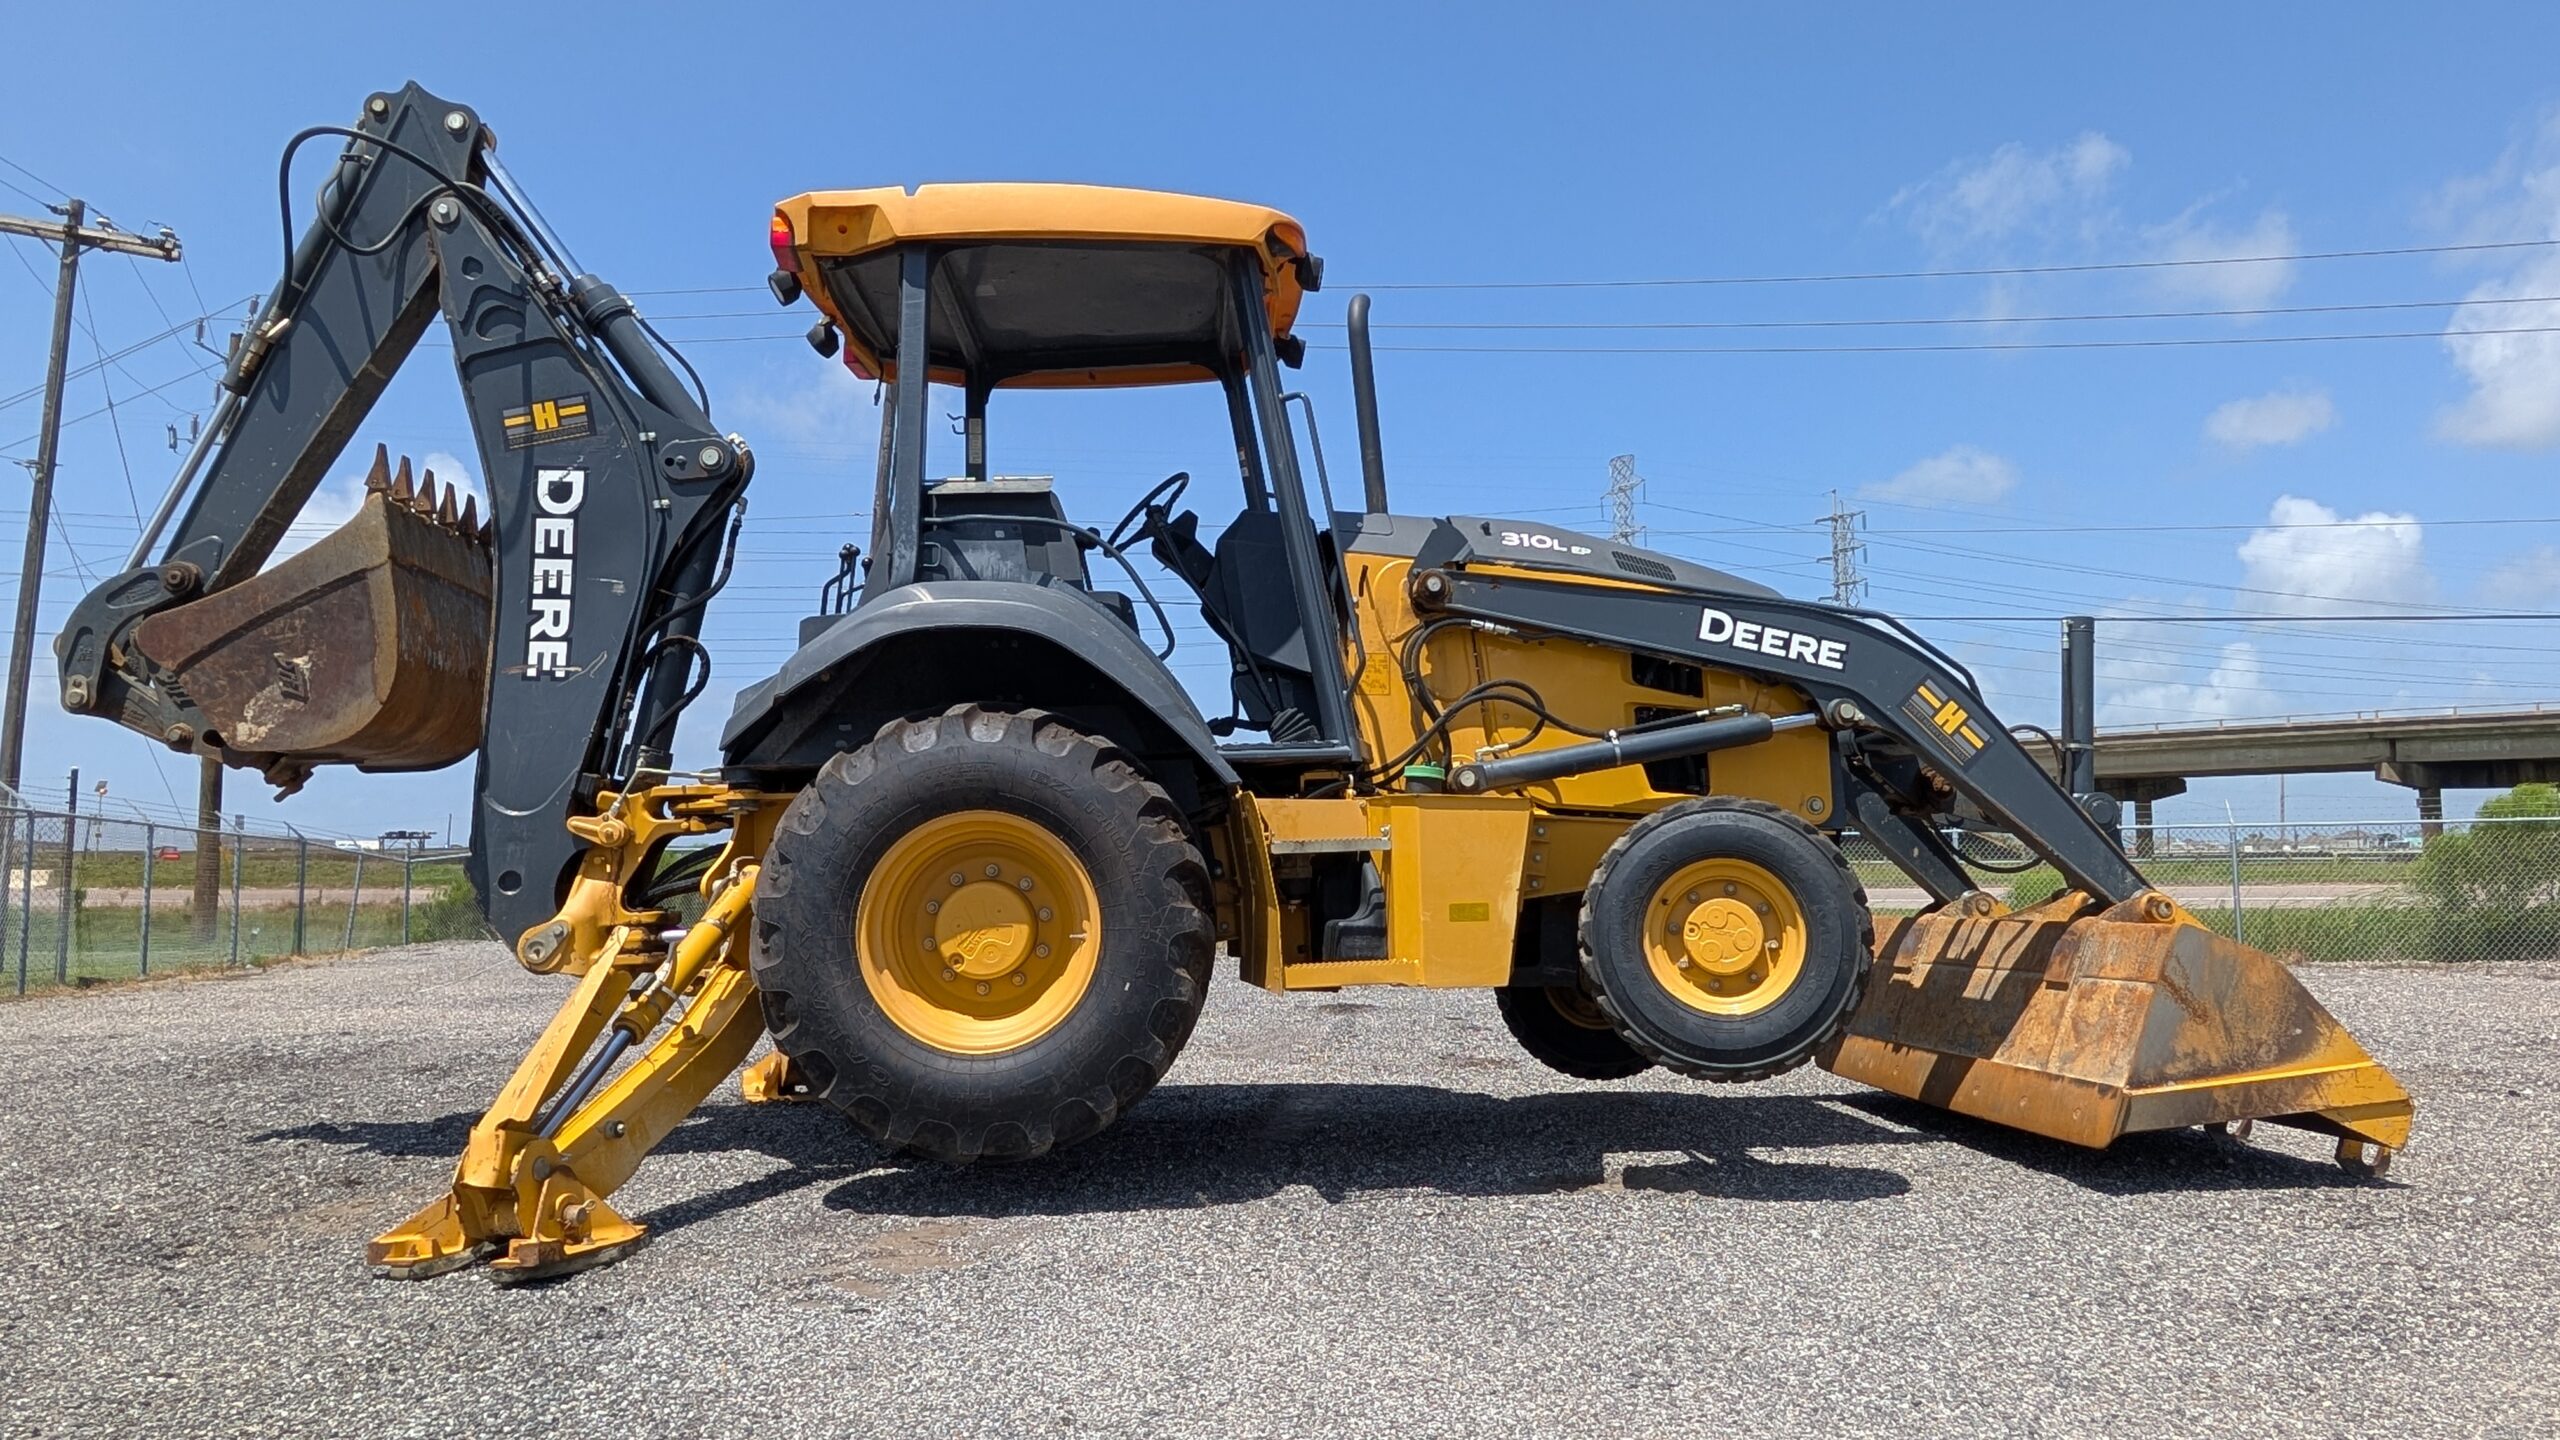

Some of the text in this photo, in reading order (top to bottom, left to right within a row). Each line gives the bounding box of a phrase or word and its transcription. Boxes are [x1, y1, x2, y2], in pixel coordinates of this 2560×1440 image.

[532, 401, 558, 430] H
[1501, 532, 1568, 552] 310L
[526, 470, 585, 677] DEERE
[1699, 608, 1847, 670] DEERE
[1934, 700, 1969, 734] H
